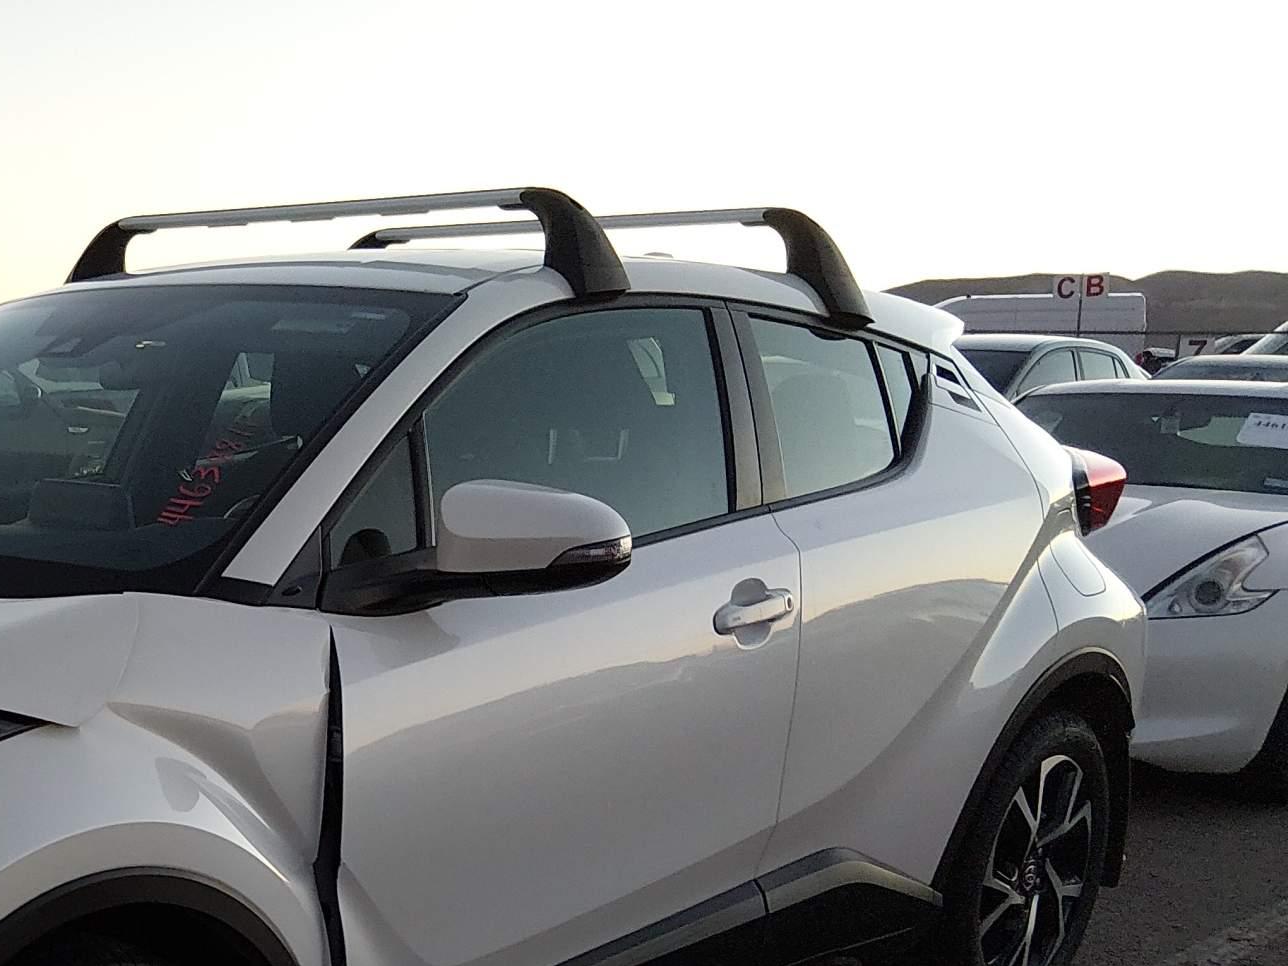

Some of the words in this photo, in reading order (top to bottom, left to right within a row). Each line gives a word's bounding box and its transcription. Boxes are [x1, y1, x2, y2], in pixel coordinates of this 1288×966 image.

[1056, 276, 1076, 299] C
[1085, 274, 1105, 297] B
[1187, 339, 1208, 356] 7
